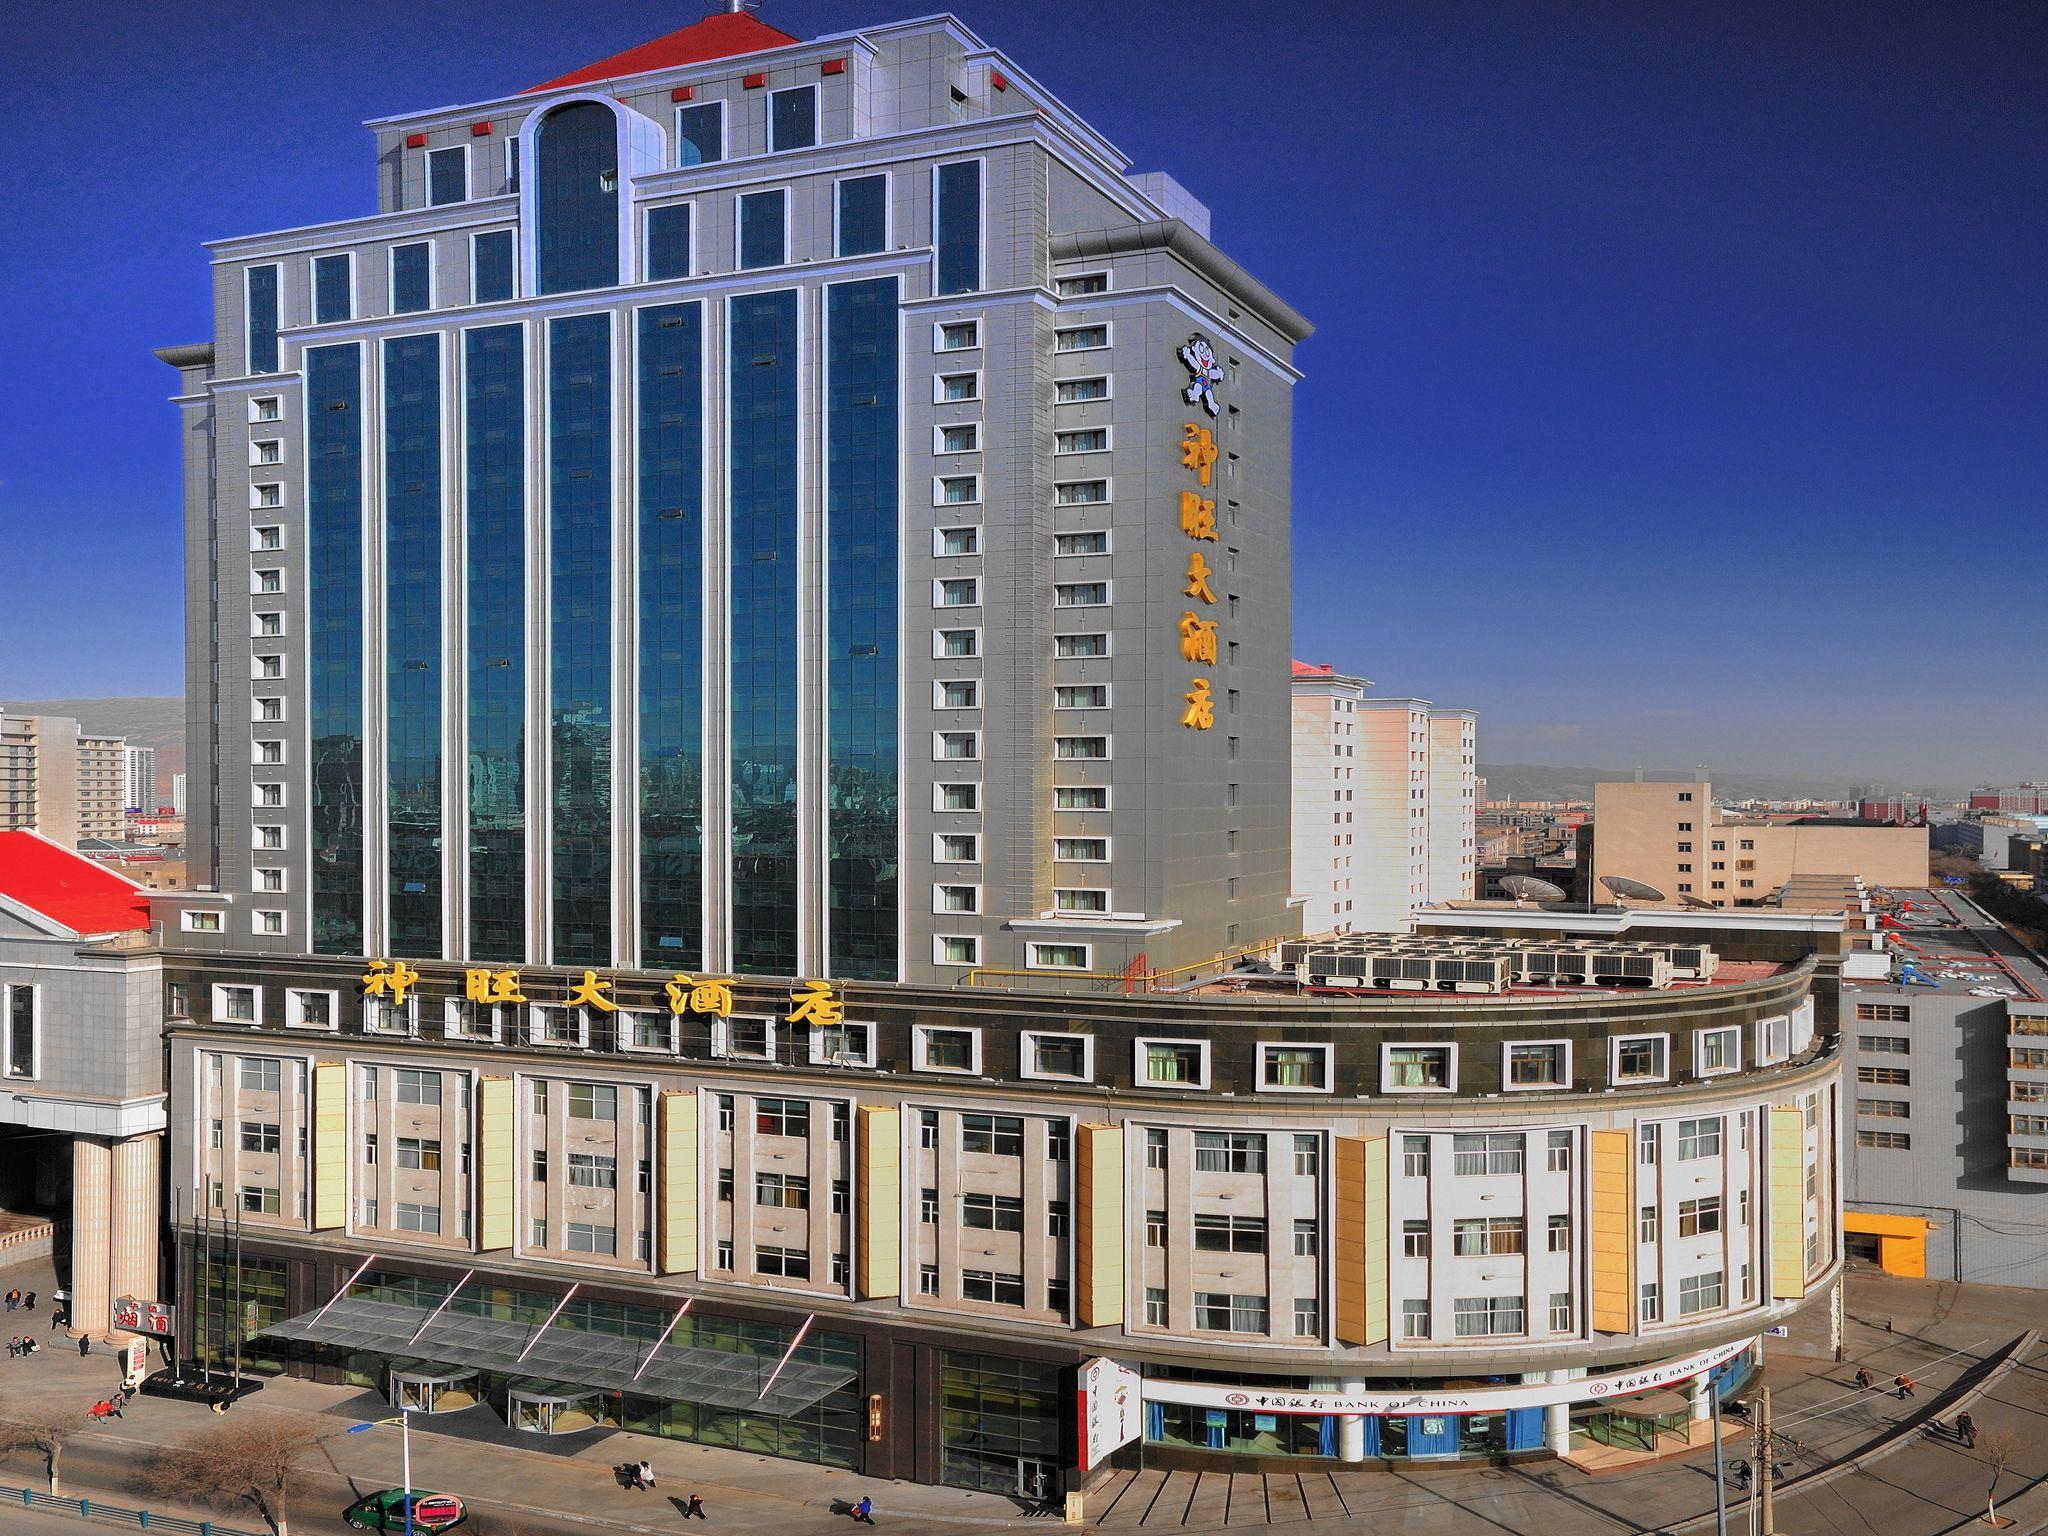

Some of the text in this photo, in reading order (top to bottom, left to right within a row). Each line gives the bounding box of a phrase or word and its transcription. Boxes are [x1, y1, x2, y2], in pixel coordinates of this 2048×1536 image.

[1180, 424, 1219, 731] 神旺大酒店
[363, 961, 843, 1026] 神旺大酒店
[118, 1309, 168, 1332] 烟酒
[1614, 1345, 1735, 1391] 中国银行 BANK OF CHINA
[1256, 1396, 1326, 1408] 中国银行
[1418, 1399, 1469, 1408] CHINA
